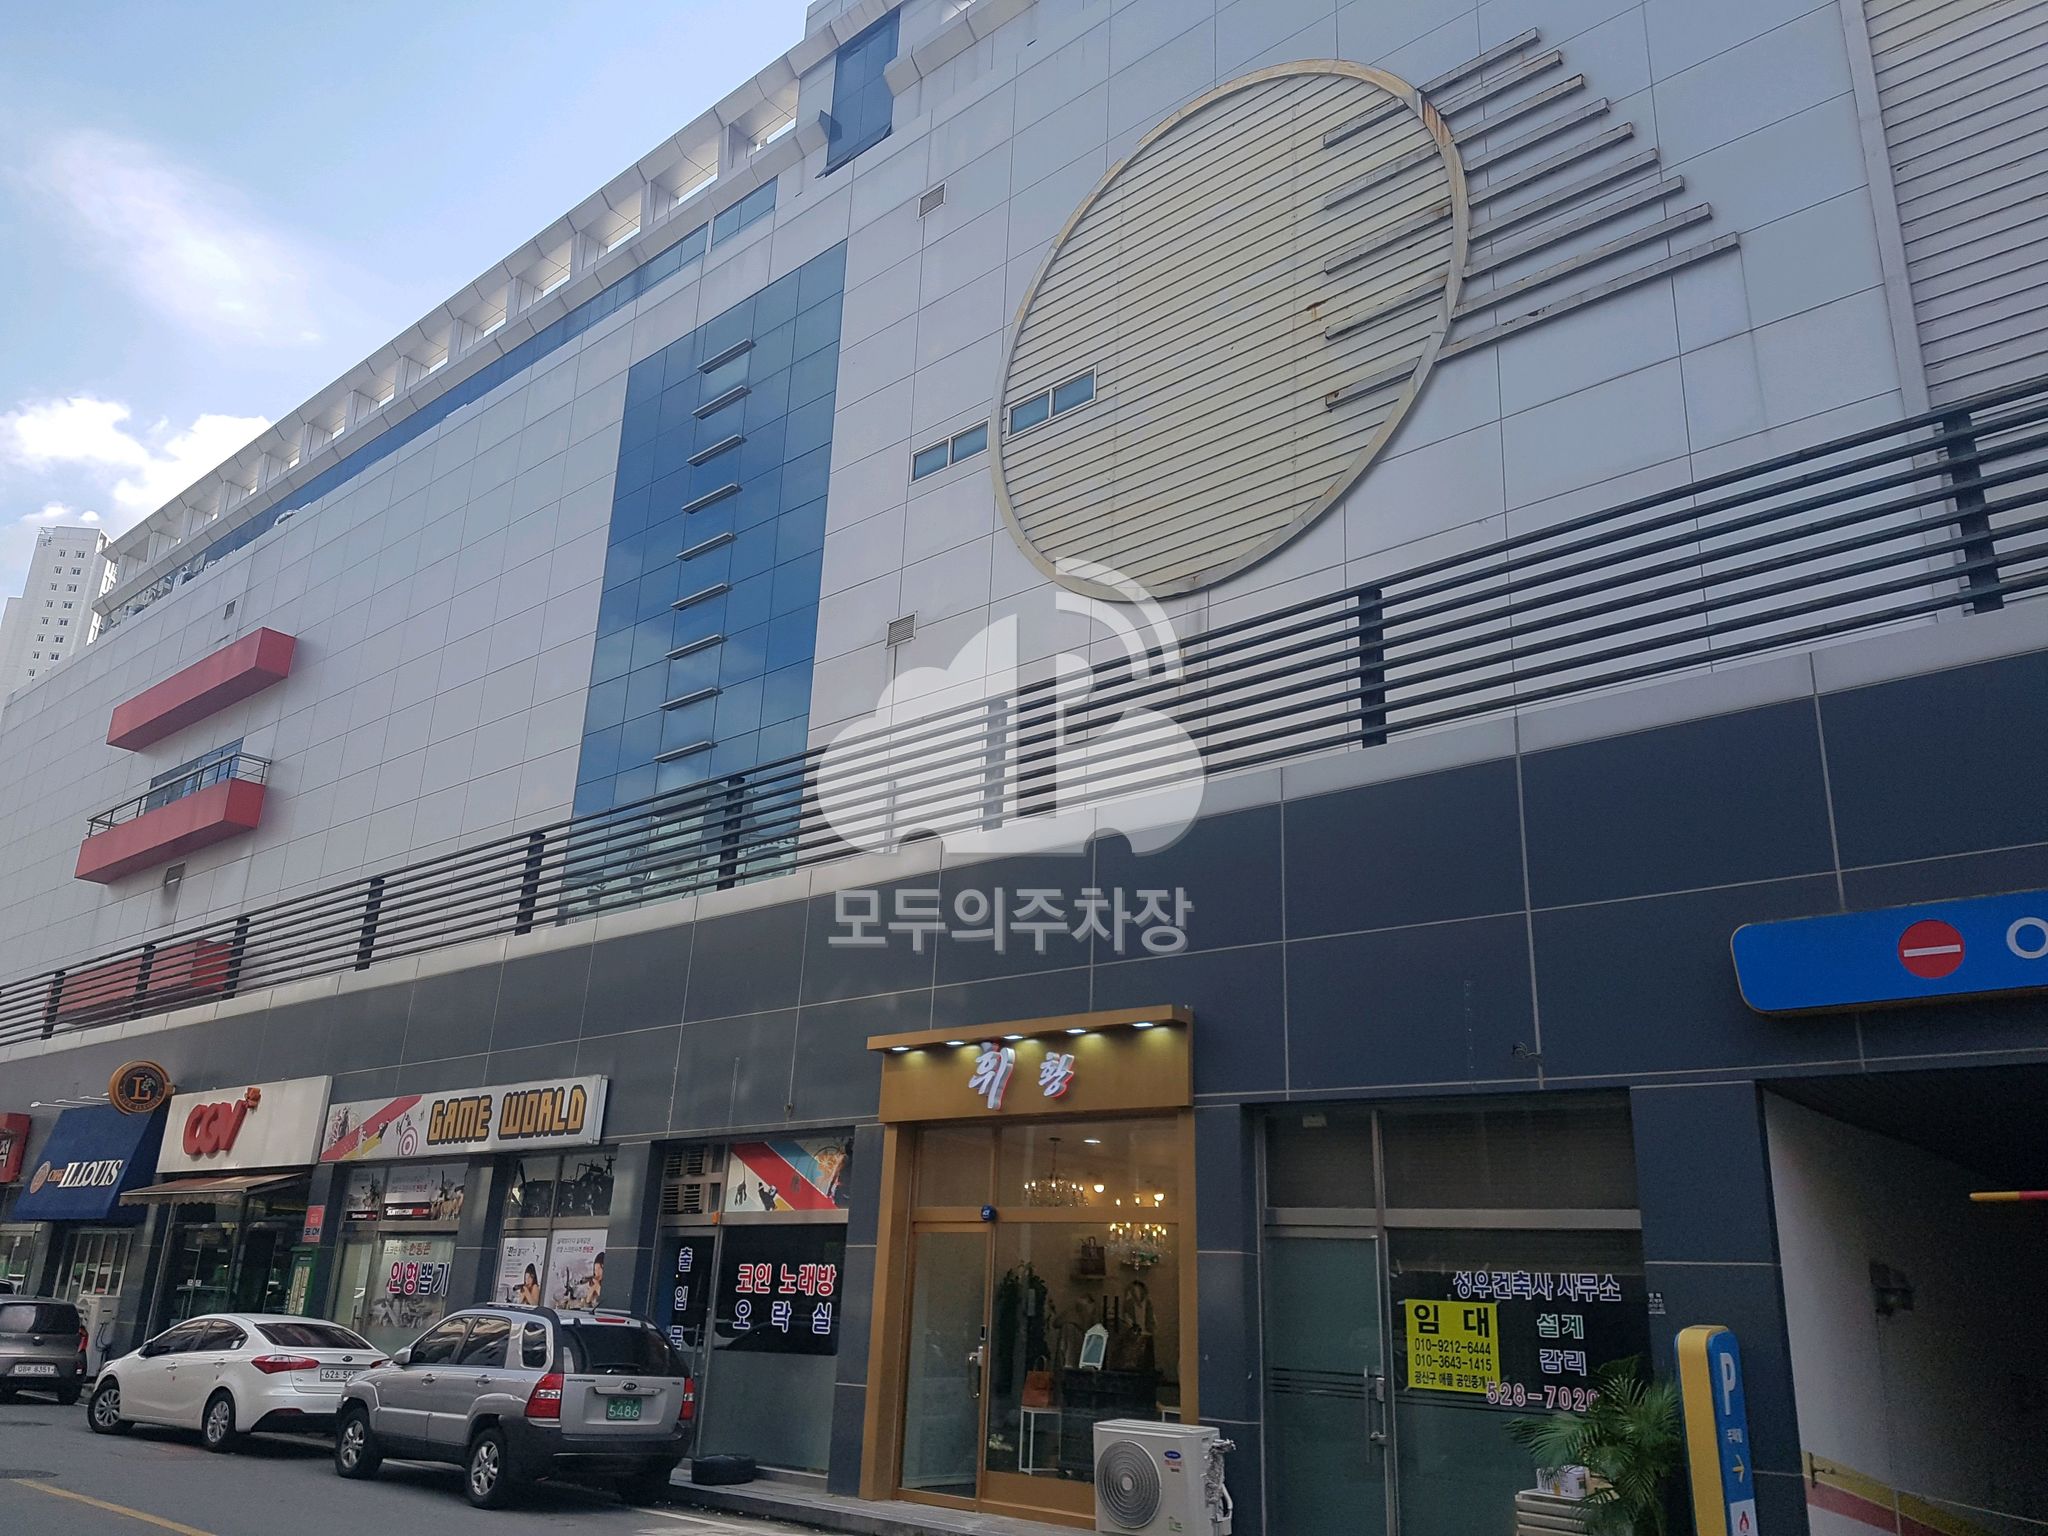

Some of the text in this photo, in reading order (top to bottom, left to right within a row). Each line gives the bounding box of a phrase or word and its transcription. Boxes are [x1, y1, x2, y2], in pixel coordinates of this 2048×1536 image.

[427, 1084, 588, 1145] GAME WORLD
[387, 1260, 450, 1297] 인형뽑기
[736, 1263, 837, 1296] 코인 노래방
[1453, 1270, 1622, 1302] 성우건축사 사무소
[1536, 1313, 1584, 1339] 설계
[1414, 1337, 1491, 1355] 010-9212-6444
[1415, 1353, 1492, 1371] 010-3643-1415
[1539, 1348, 1587, 1376] 감리
[608, 1404, 640, 1418] 5486
